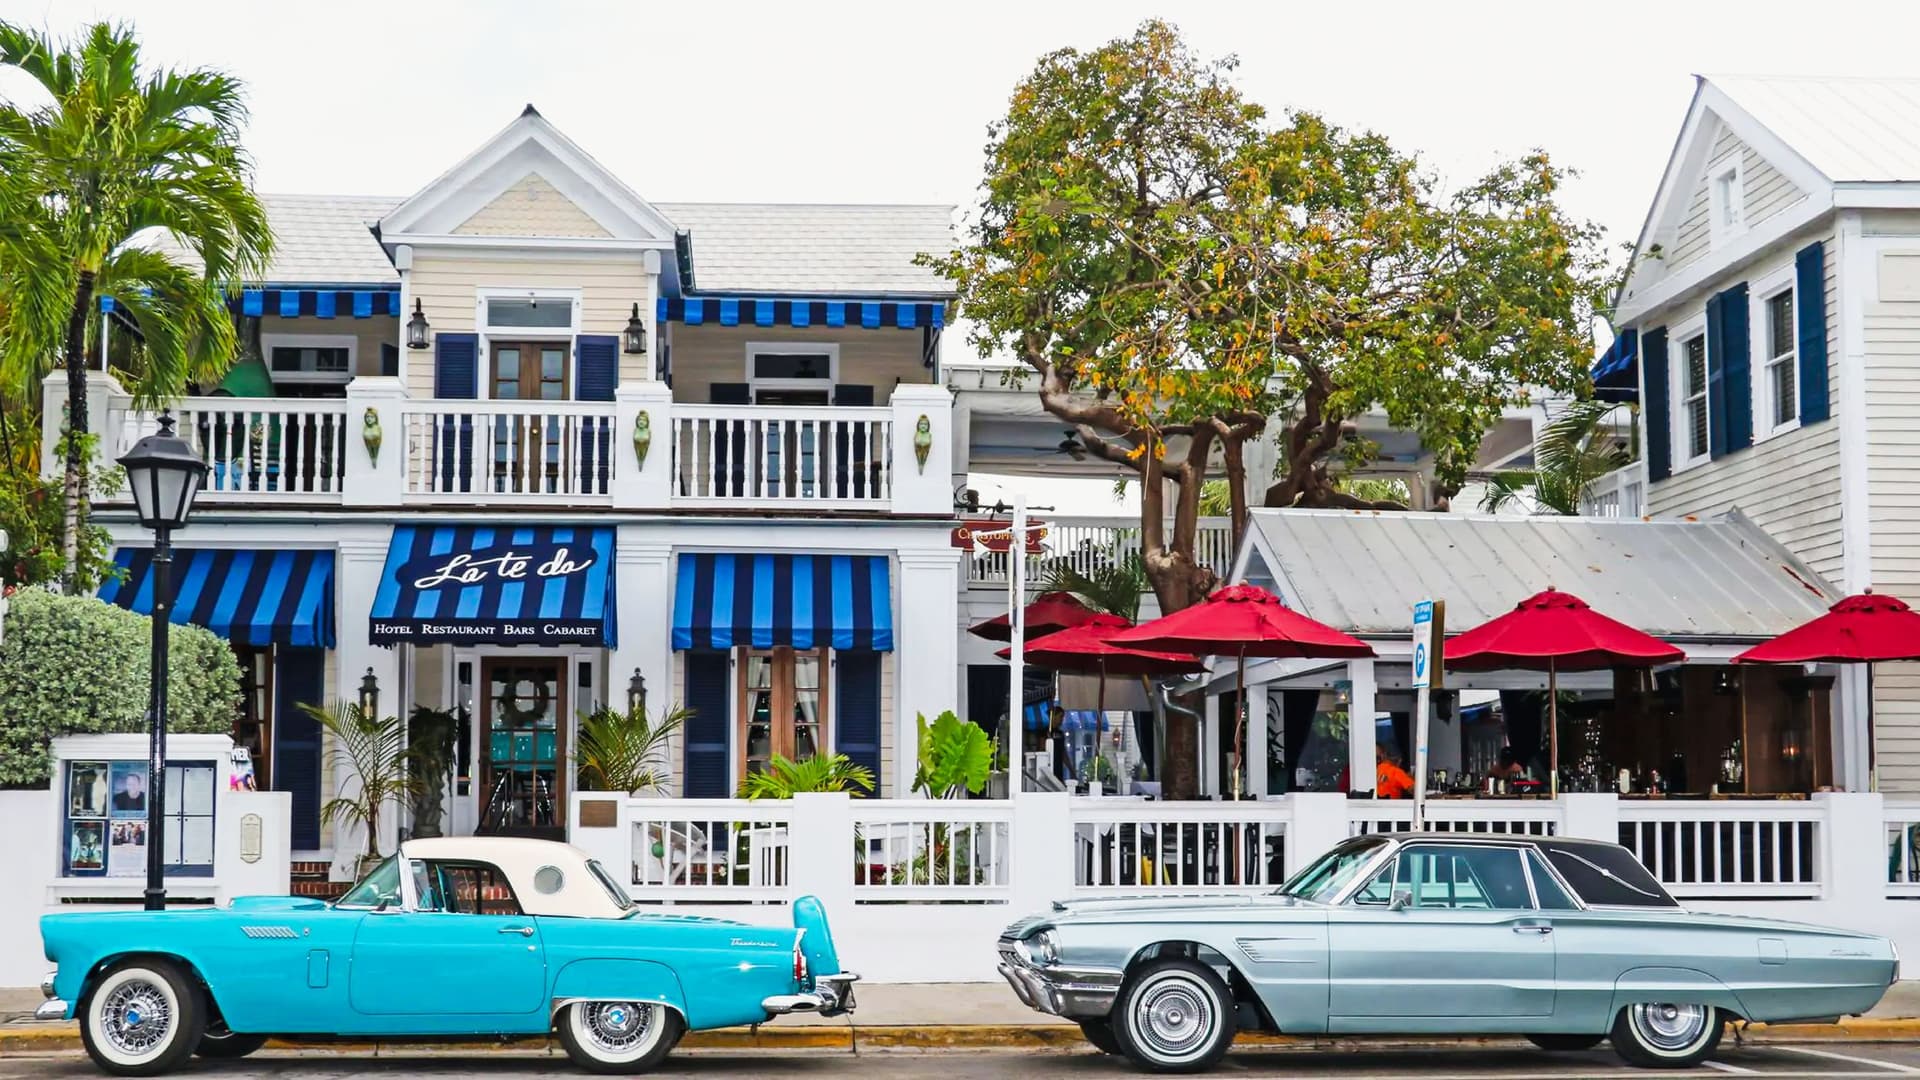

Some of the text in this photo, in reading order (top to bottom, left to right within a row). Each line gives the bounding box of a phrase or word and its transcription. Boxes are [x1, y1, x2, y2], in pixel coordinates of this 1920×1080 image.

[414, 547, 593, 588] La te da
[374, 623, 597, 635] HOTEL RESTAURANT BARS CABARET
[1417, 649, 1424, 673] P
